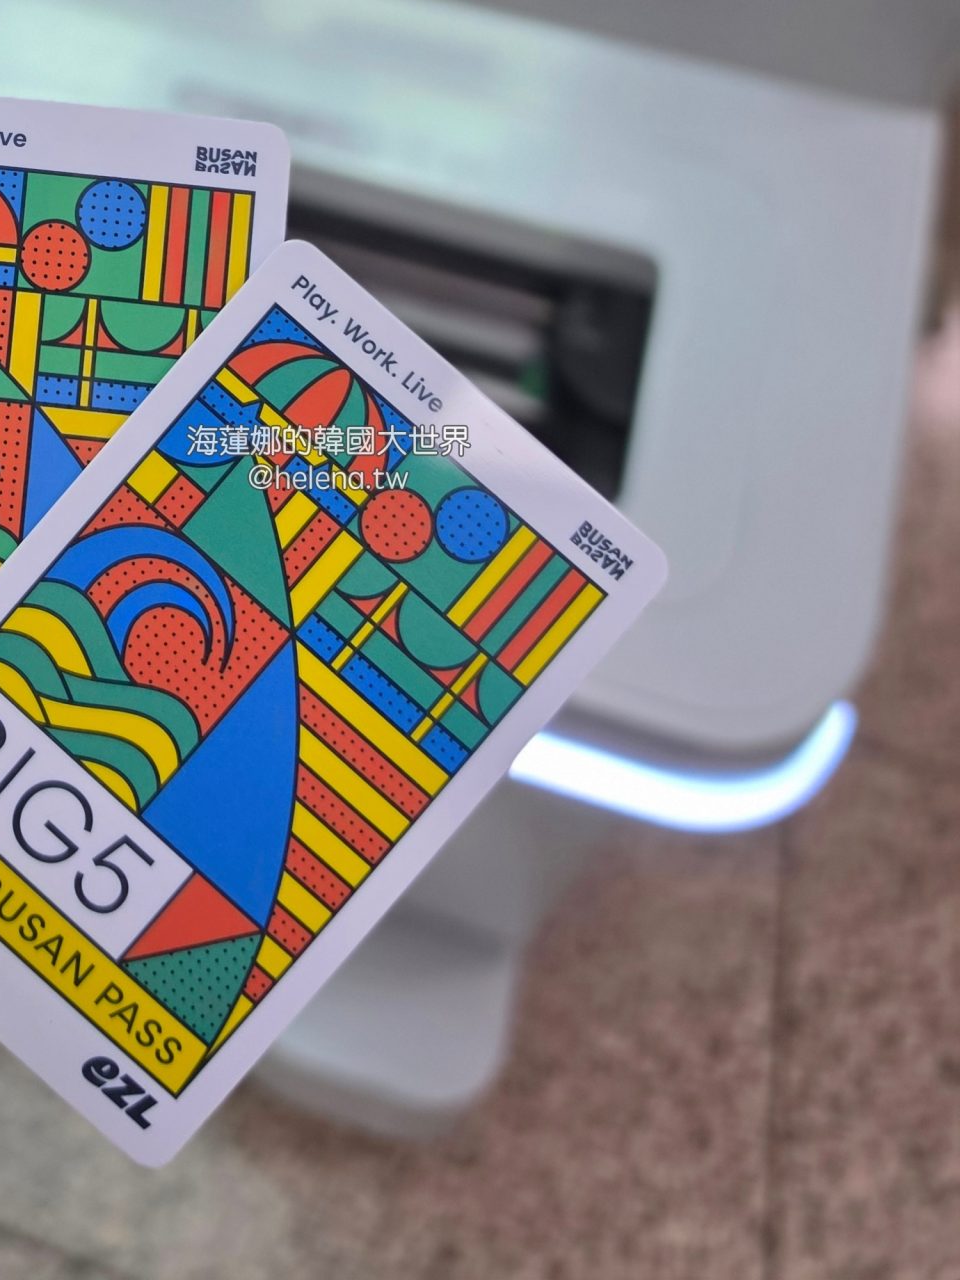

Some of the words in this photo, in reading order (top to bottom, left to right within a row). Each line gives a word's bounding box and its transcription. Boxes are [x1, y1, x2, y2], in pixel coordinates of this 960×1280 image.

[196, 146, 258, 164] BUSAN
[290, 274, 337, 325] Play.
[343, 317, 397, 379] Work.
[400, 370, 443, 413] Live
[578, 520, 634, 571] BUSAN
[94, 982, 182, 1065] PASS
